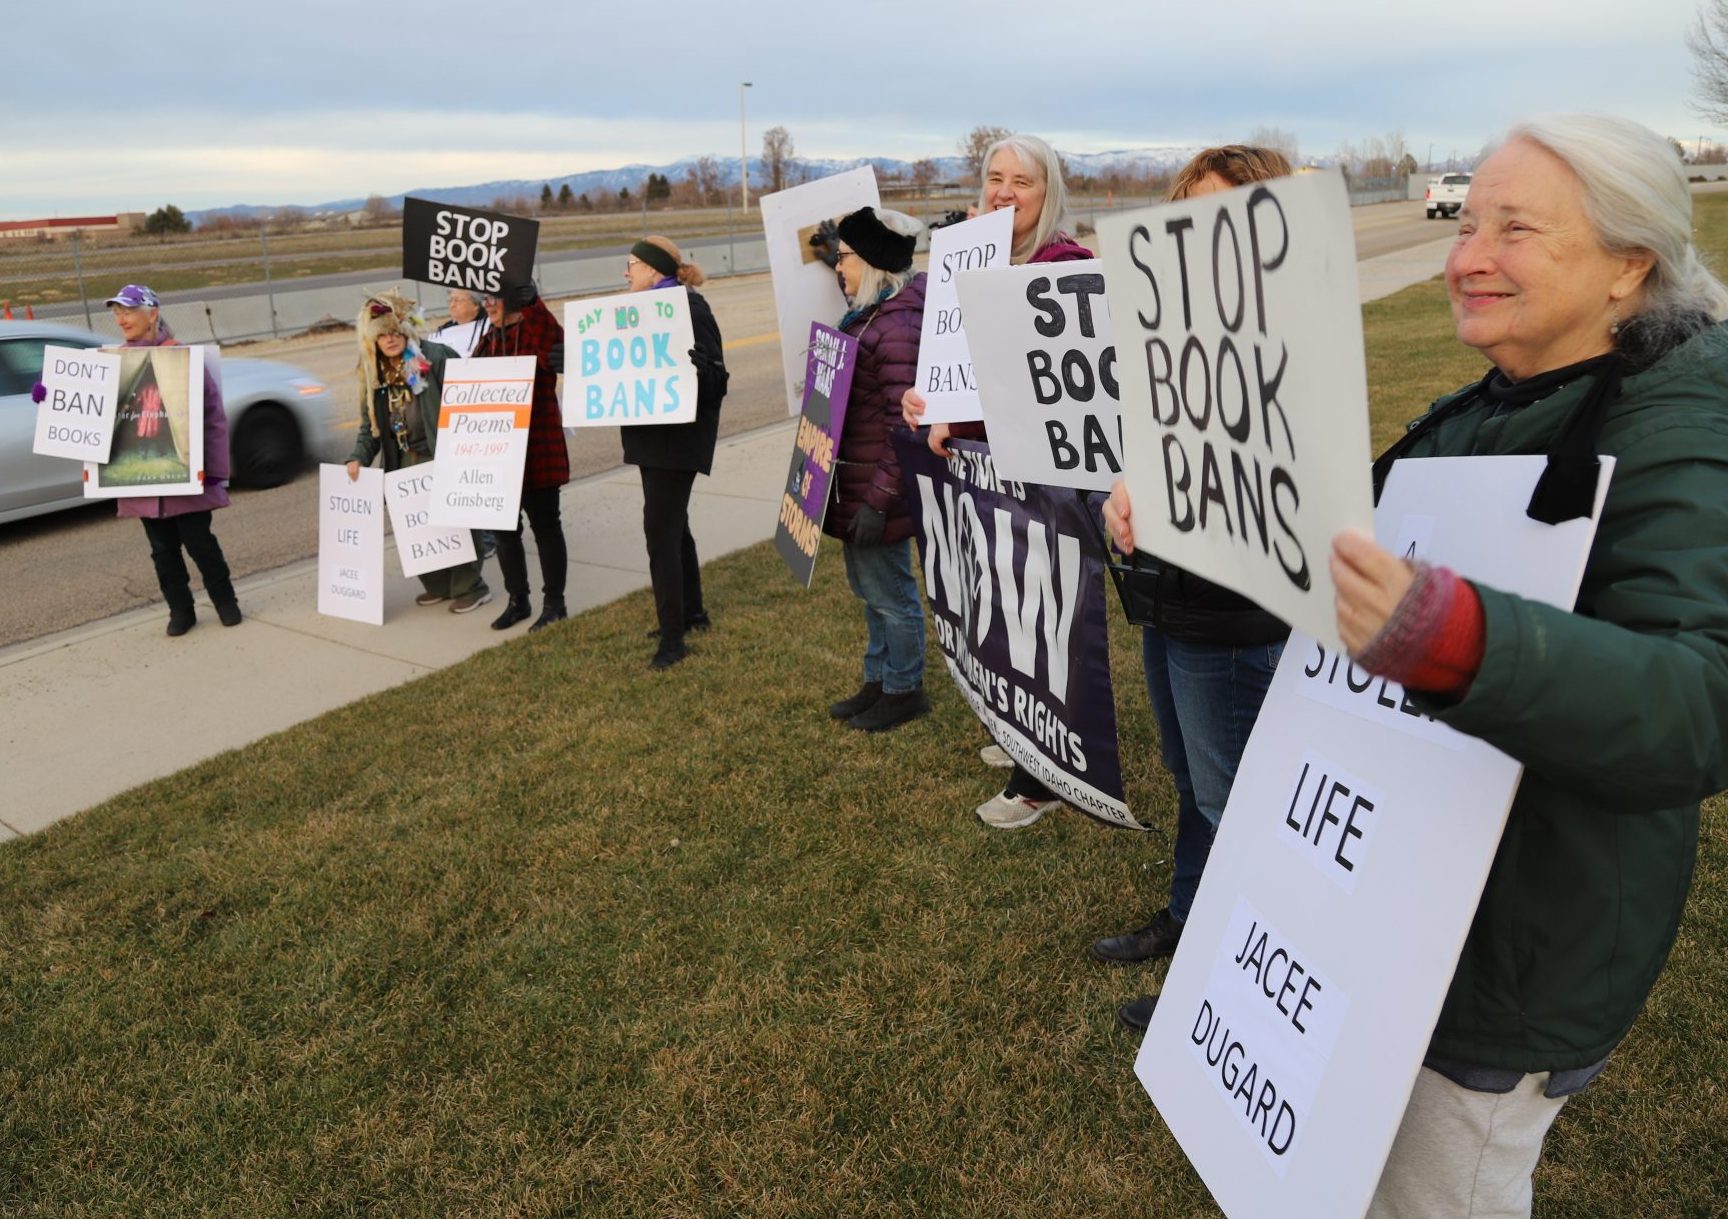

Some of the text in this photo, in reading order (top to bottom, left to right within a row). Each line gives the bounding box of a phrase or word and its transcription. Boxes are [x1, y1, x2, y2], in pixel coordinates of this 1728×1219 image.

[436, 210, 509, 245] STOP
[430, 234, 508, 272] BOOK
[941, 243, 996, 283] STOP
[1129, 186, 1289, 337] STOP
[428, 259, 501, 293] BANS
[578, 308, 602, 334] SAY
[656, 302, 674, 318] TO
[936, 307, 962, 335] BO
[55, 359, 109, 382] DON'T
[581, 332, 677, 377] BOOK
[1026, 346, 1120, 405] BOO
[52, 389, 104, 417] BAN
[444, 383, 531, 405] Collected
[586, 375, 680, 419] BANS
[1145, 335, 1296, 462] BOOK
[48, 426, 101, 447] BOOKS
[454, 415, 513, 434] Poems
[454, 442, 510, 456] 1947-1997
[797, 415, 834, 473] EMPIRE
[1045, 414, 1124, 474] BA
[398, 475, 433, 498] STO
[459, 469, 493, 484] Allen
[330, 496, 372, 515] STOLEN
[405, 510, 429, 528] BO
[446, 492, 504, 511] Ginsberg
[1162, 433, 1311, 592] BANS
[337, 528, 359, 546] LIFE
[780, 493, 820, 558] STORMS
[411, 534, 462, 559] BANS
[916, 473, 1081, 706] NOW
[932, 613, 956, 653] OR
[1014, 684, 1088, 772] RIGHTS
[1002, 730, 1128, 824] SOUTHWEST IDAHO CHAPTER
[1286, 762, 1375, 872] LIFE
[1235, 921, 1322, 1034] JACEE
[1191, 999, 1296, 1156] DUGARD
